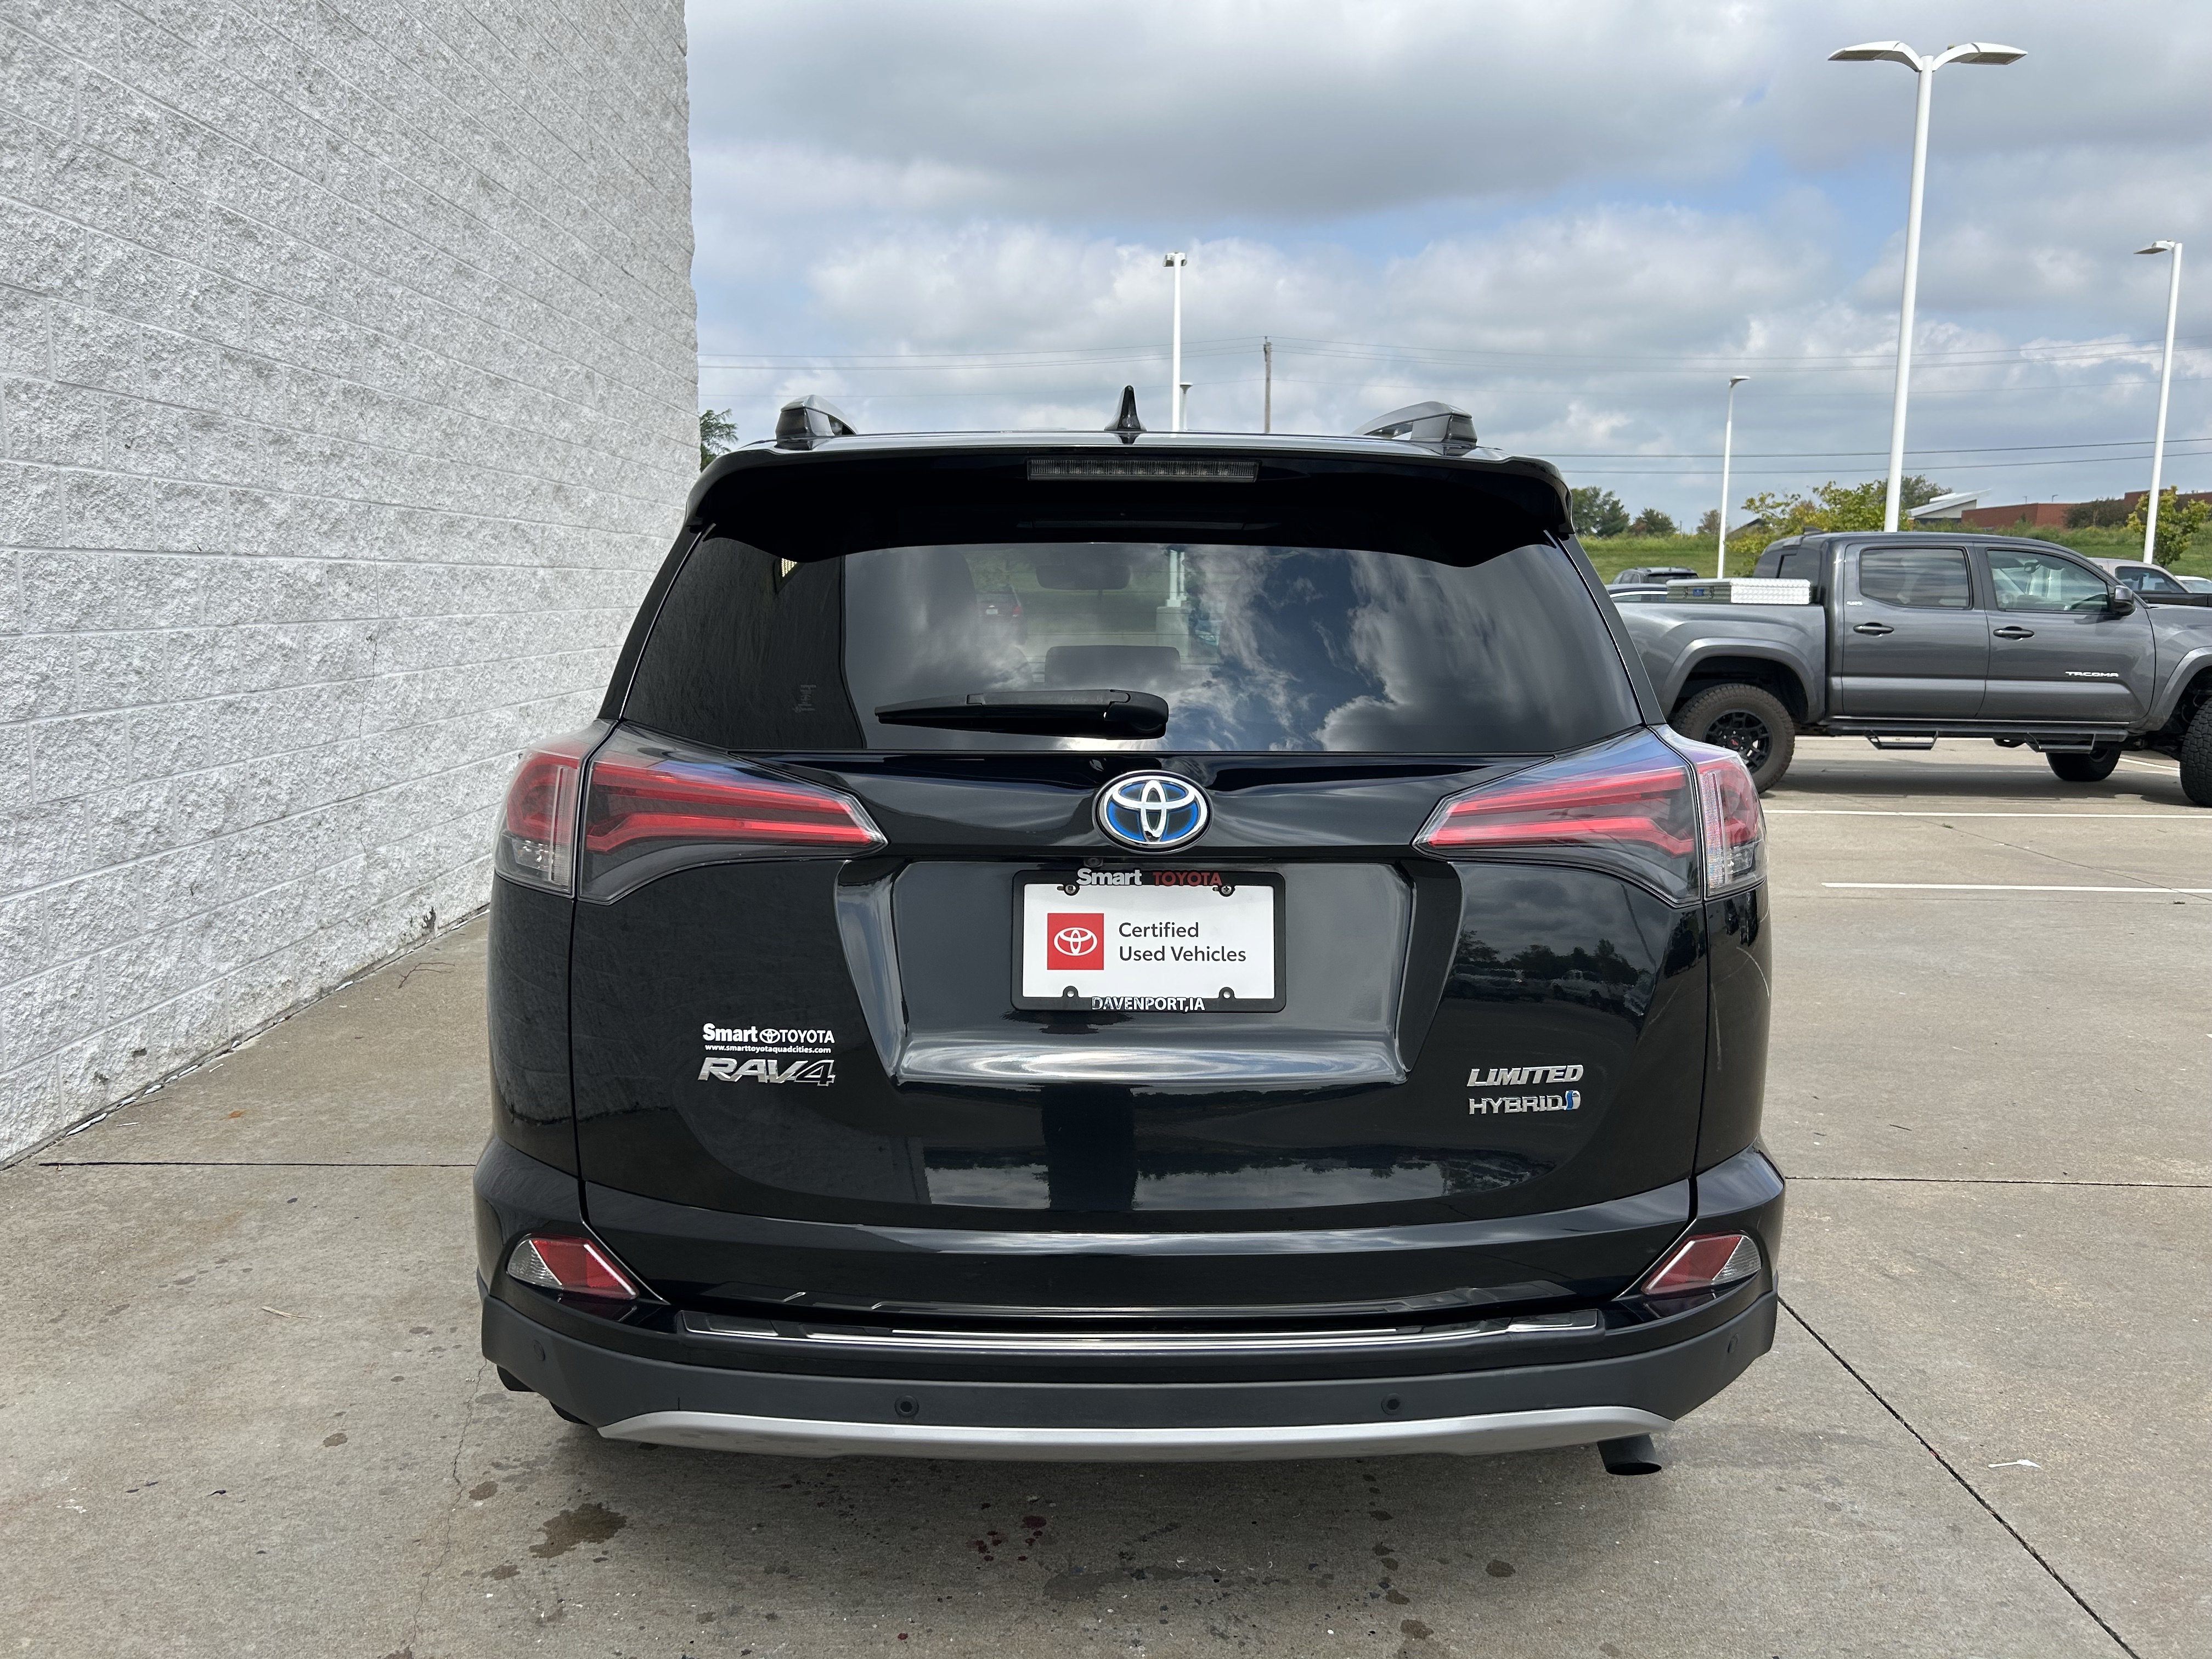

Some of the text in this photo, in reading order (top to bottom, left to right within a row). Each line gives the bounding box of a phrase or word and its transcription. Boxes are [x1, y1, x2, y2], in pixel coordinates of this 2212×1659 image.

[1076, 868, 1222, 886] Smart TOYOTA
[1119, 922, 1199, 938] Certified
[1119, 946, 1246, 961] Used Vehicles
[703, 1023, 835, 1043] Smart TOYOTA
[705, 1044, 831, 1053] www.smarttoyotaquadcities.com
[697, 1057, 836, 1086] RAV4
[1467, 1064, 1584, 1087] LIMITED
[1469, 1095, 1564, 1115] HYBRID
